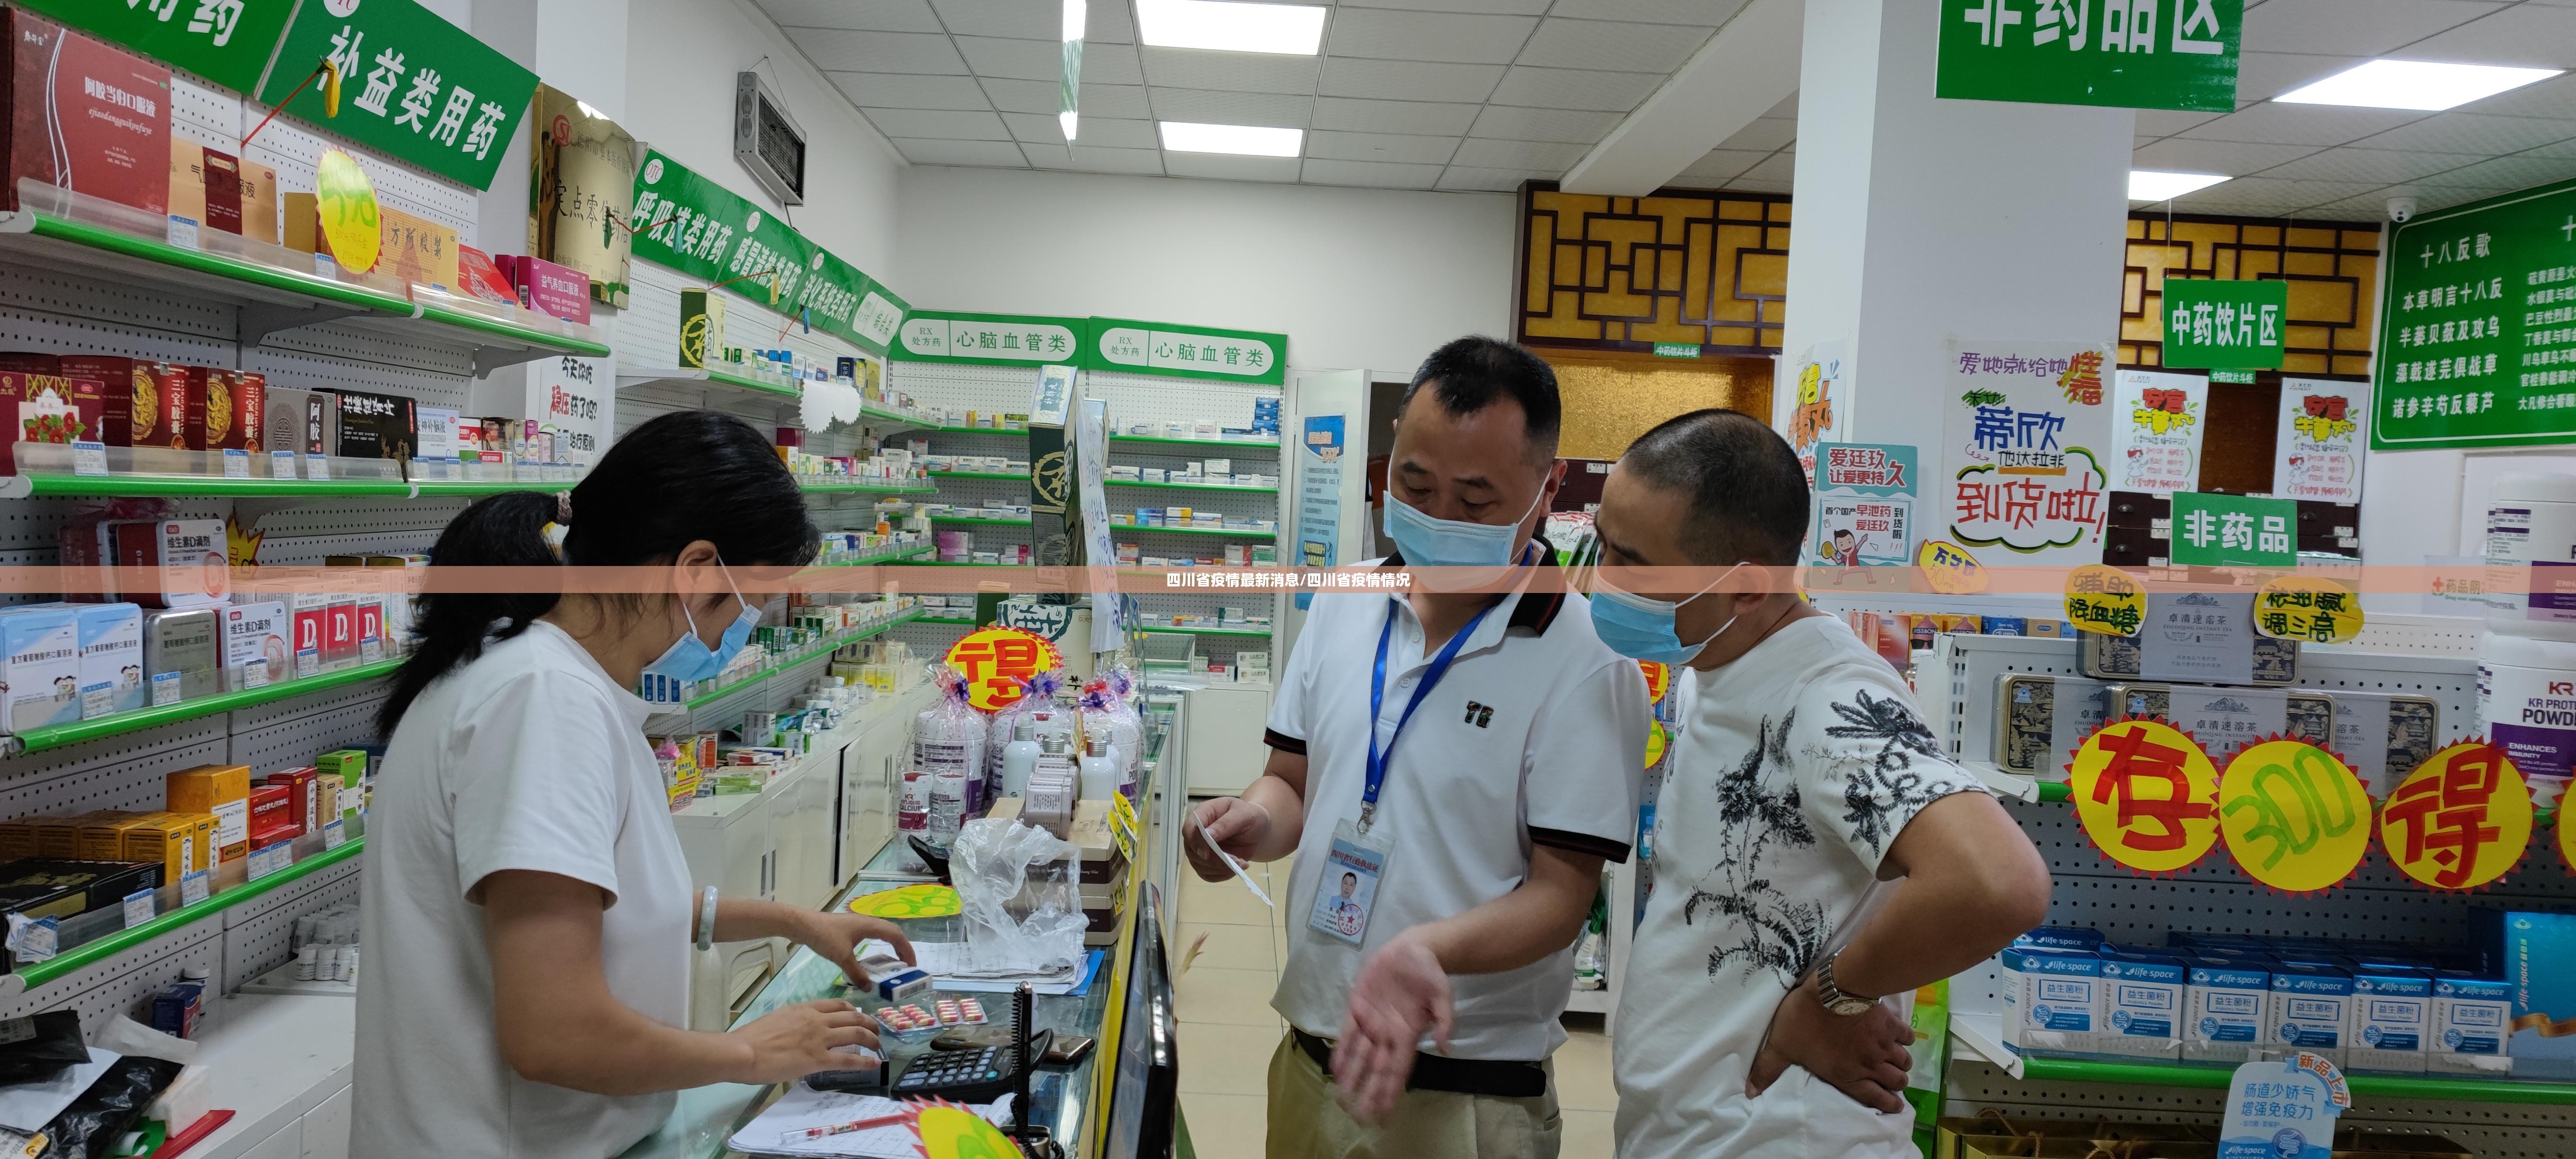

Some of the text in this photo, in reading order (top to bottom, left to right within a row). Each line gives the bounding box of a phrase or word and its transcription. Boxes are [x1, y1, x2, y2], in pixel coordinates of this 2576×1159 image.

[85, 76, 155, 118] 阿胶当归口服液
[316, 25, 506, 161] 补益类用药
[645, 162, 664, 179] OTC
[554, 178, 629, 244] 定点零售药店
[747, 215, 760, 228] OTC
[632, 190, 733, 265] 呼吸道类用药
[2420, 232, 2492, 268] 十八反歌
[541, 273, 580, 299] 益气养血口服液
[798, 273, 858, 323] 消化系统类用药
[2402, 277, 2503, 313] 本草明言十八反
[2171, 301, 2279, 348] 中药饮片区
[912, 336, 941, 348] 处方药
[956, 330, 1067, 353] 心脑血管类
[1110, 345, 1140, 357] 处方药
[1119, 336, 1133, 345] RX
[1155, 345, 1265, 368] 心脑血管类
[1959, 352, 2068, 377] 爱她就给她
[562, 355, 593, 385] 今天你吃
[2212, 371, 2253, 383] 中药饮片斗柜
[171, 379, 181, 434] 三宝胶囊
[245, 387, 255, 439] 三宝胶囊
[309, 402, 321, 441] 阿胶
[1974, 405, 2066, 452] 蒂欣
[1828, 448, 1886, 470] 爱廷玖
[1998, 451, 2066, 469] 他达拉非
[1828, 460, 1906, 487] 让爱更持久
[1825, 504, 1892, 518] 首个国产早泄药
[1892, 507, 1904, 539] 到货啦
[167, 535, 210, 549] 维生素D滴剂
[2184, 509, 2289, 553] 非药品
[230, 618, 271, 635] 维生素D滴剂
[2069, 598, 2141, 634] 降血糖
[2168, 613, 2227, 626] 卓清速溶茶
[2262, 613, 2336, 643] 调三高
[954, 639, 1041, 706] 得
[2528, 698, 2544, 708] KR
[2196, 719, 2257, 732] 卓清速溶茶
[2508, 742, 2558, 754] ENHANCES
[2508, 750, 2541, 759] IMMUNITY
[2092, 725, 2212, 851] 存
[2222, 746, 2356, 871] 300
[2385, 746, 2503, 888] 得
[2047, 983, 2083, 995] 益生菌粉
[2127, 989, 2165, 1002] 益生菌粉
[2244, 1082, 2316, 1102] 肠道少娇气
[2298, 1054, 2349, 1107] 新品上市
[2241, 1101, 2314, 1121] 增强免疫力
